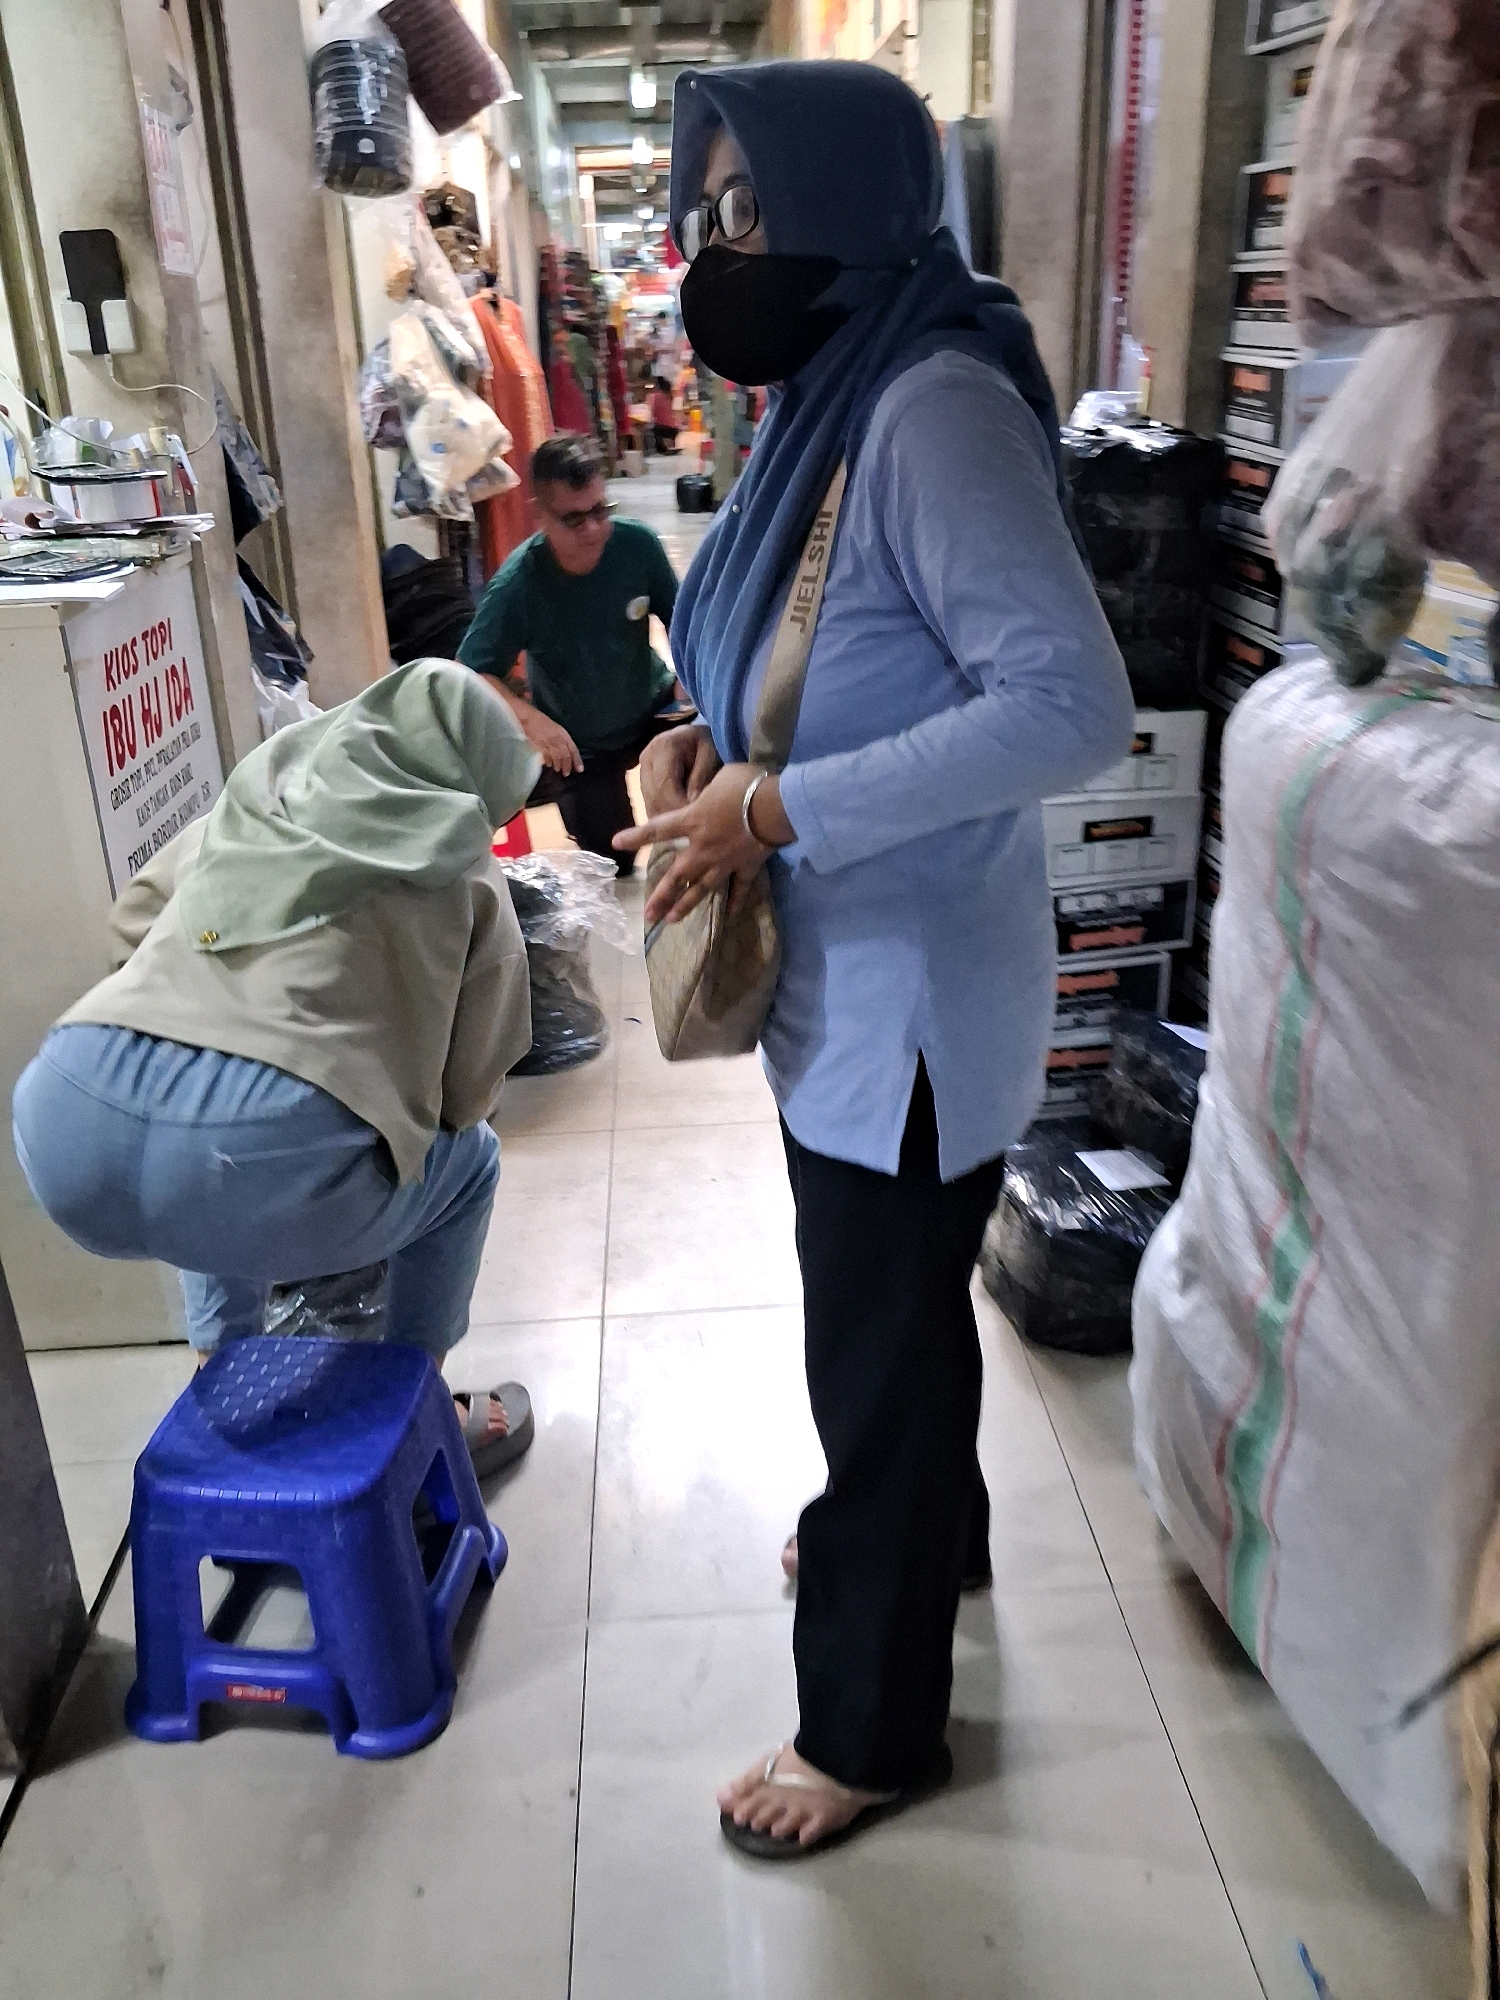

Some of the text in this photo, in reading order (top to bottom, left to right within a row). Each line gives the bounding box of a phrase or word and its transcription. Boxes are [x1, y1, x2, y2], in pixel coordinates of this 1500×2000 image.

[104, 617, 173, 692] KIOS TOPI
[103, 694, 137, 777] IBU
[140, 676, 163, 748] HJ
[165, 657, 194, 727] IDA
[127, 839, 154, 877] PRIMA
